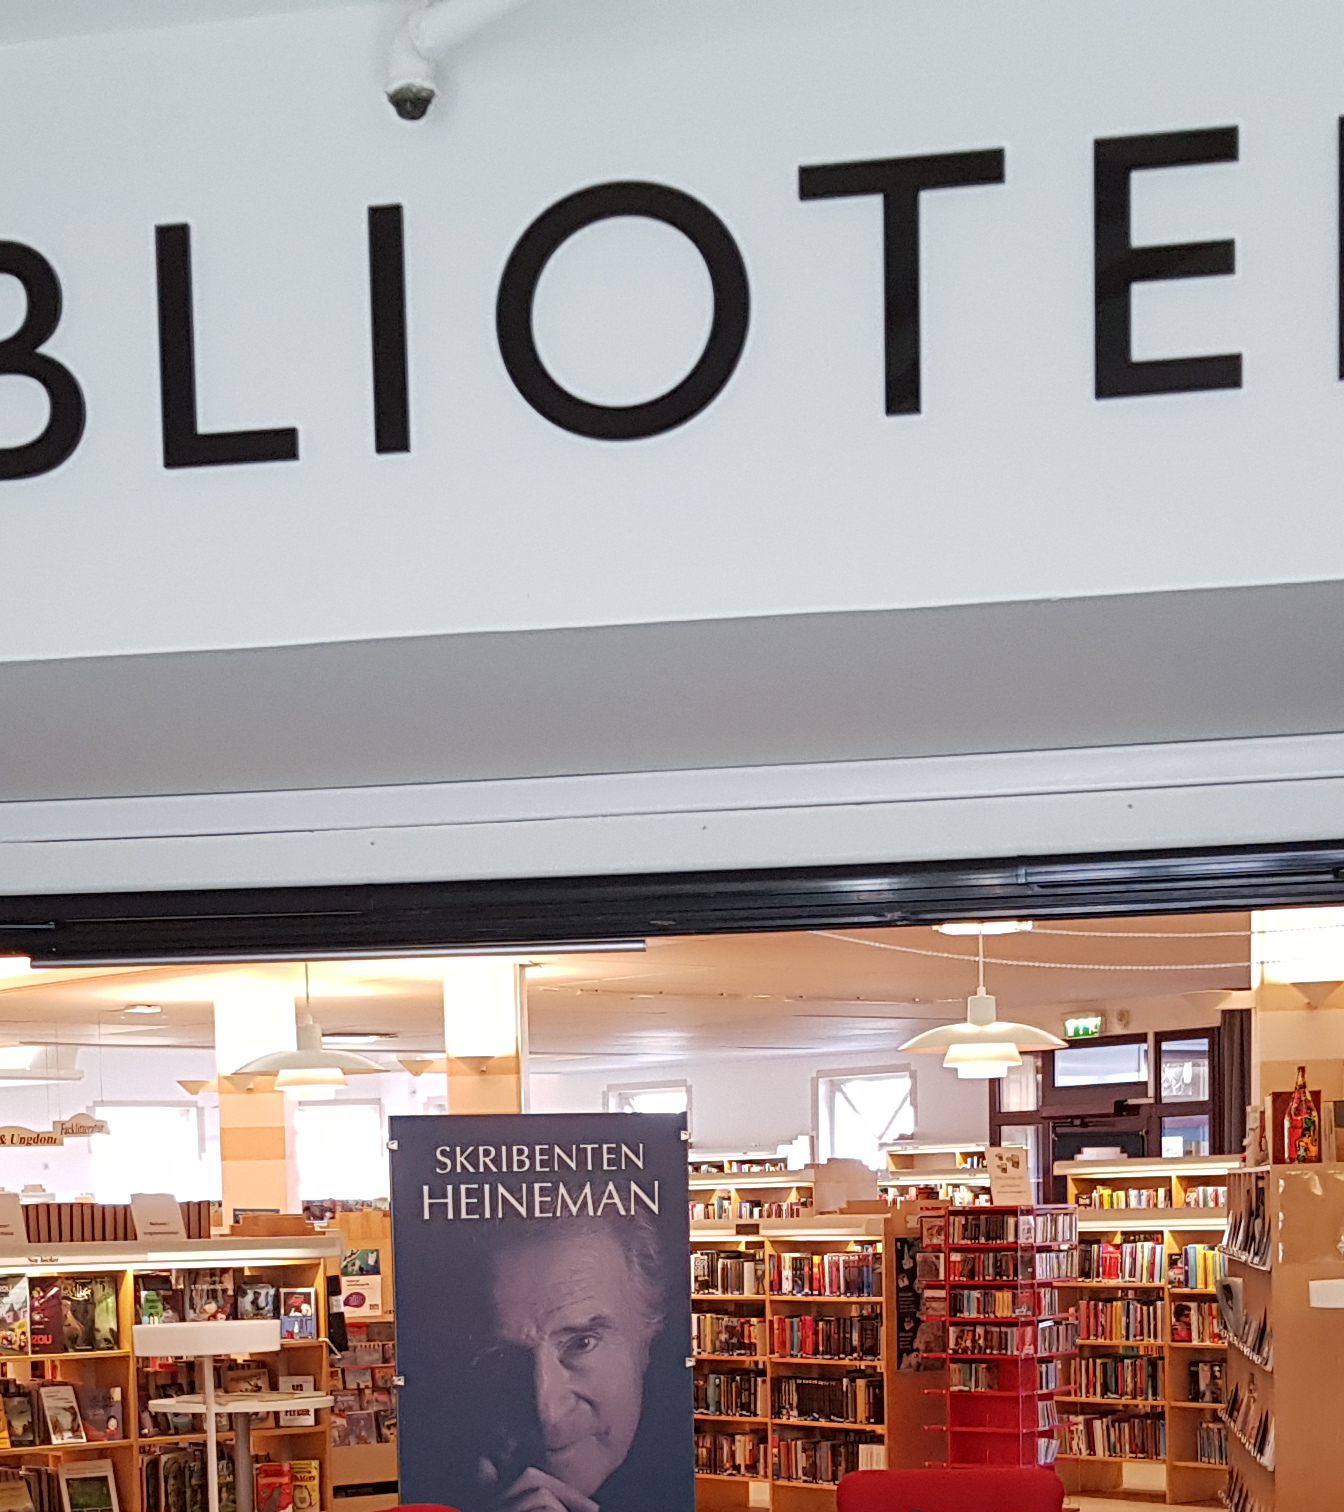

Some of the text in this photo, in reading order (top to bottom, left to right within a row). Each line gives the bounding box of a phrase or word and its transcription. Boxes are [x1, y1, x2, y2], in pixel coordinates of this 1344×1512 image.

[10, 1133, 57, 1147] Ungdom
[435, 1143, 644, 1174] SKRIBENTEN
[422, 1180, 659, 1220] HEINEMAN
